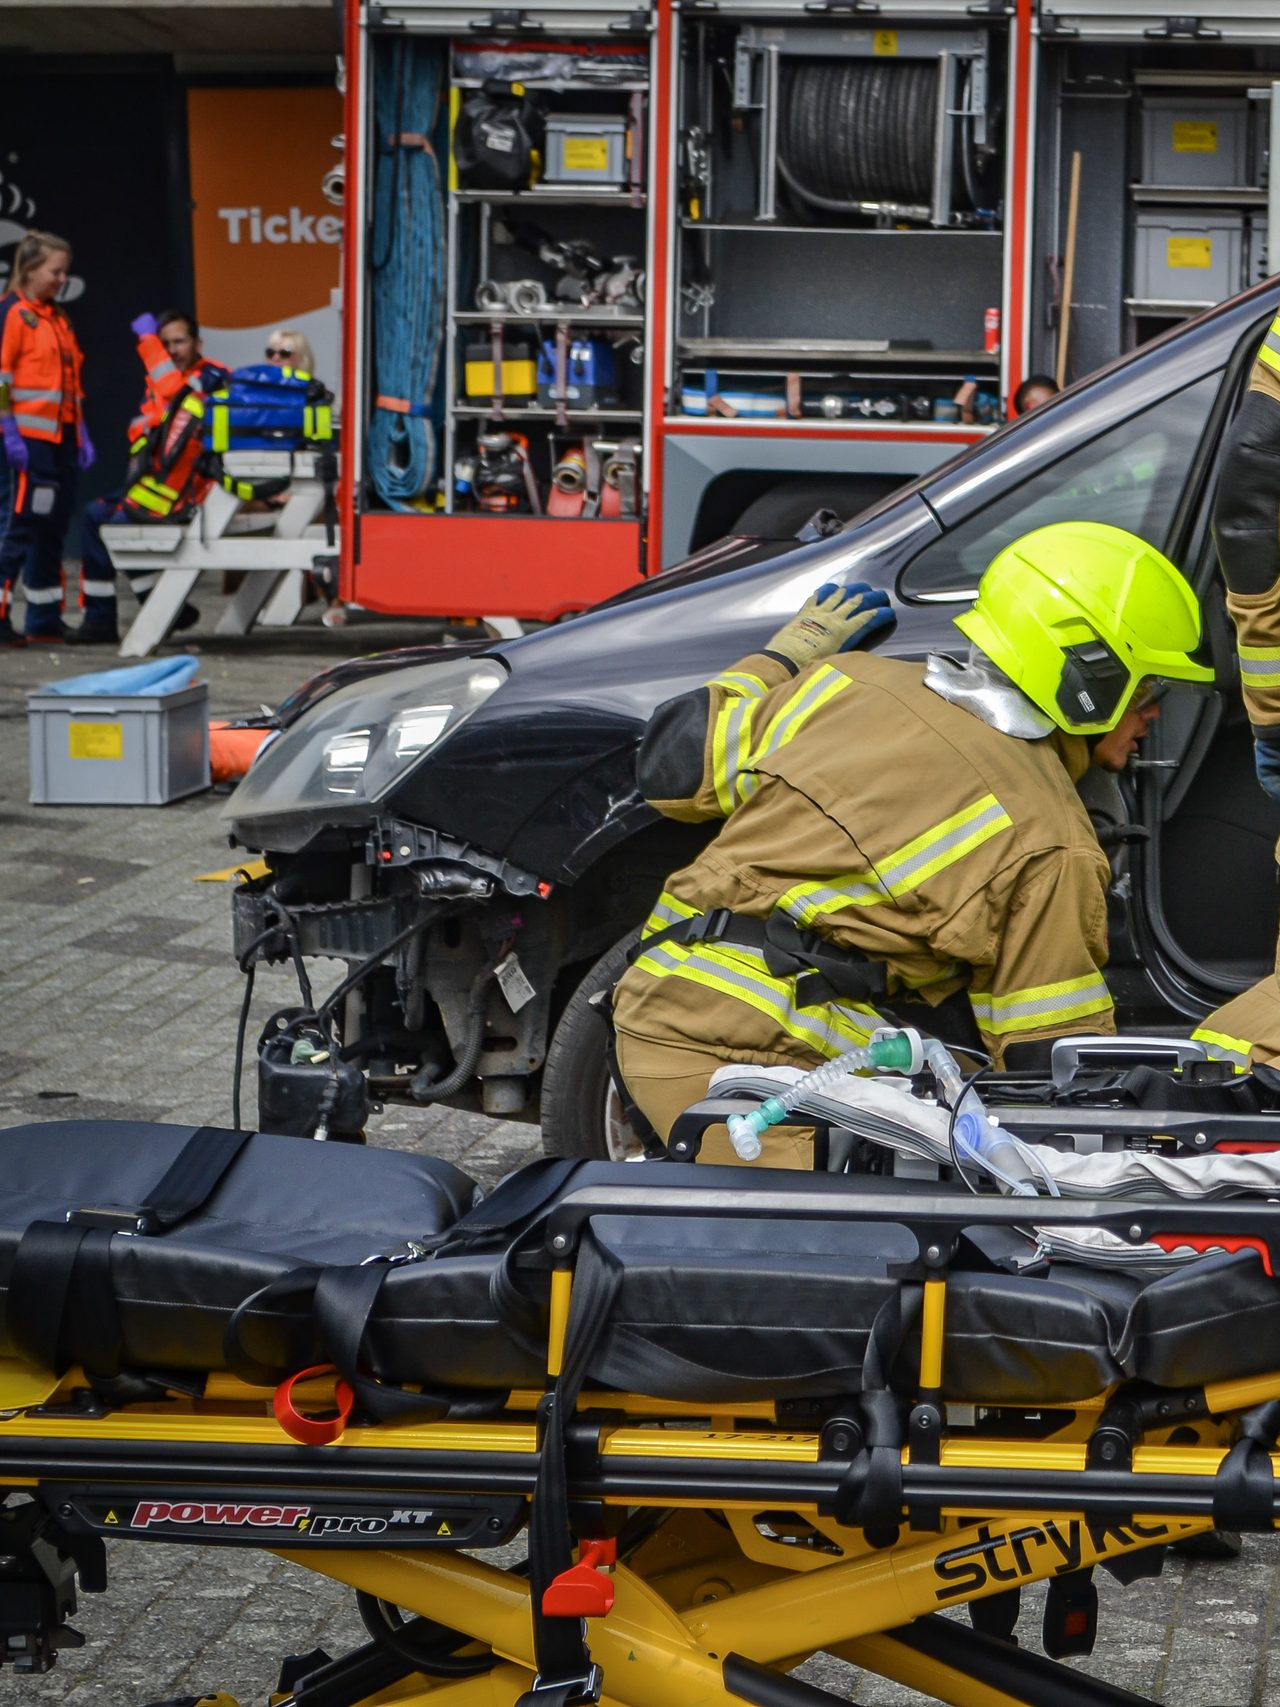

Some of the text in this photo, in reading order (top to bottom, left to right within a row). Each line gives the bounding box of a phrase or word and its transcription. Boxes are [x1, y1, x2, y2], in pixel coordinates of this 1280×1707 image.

[217, 206, 345, 244] Ticke
[131, 1502, 433, 1535] power pro XT
[933, 1520, 1193, 1600] stryk
